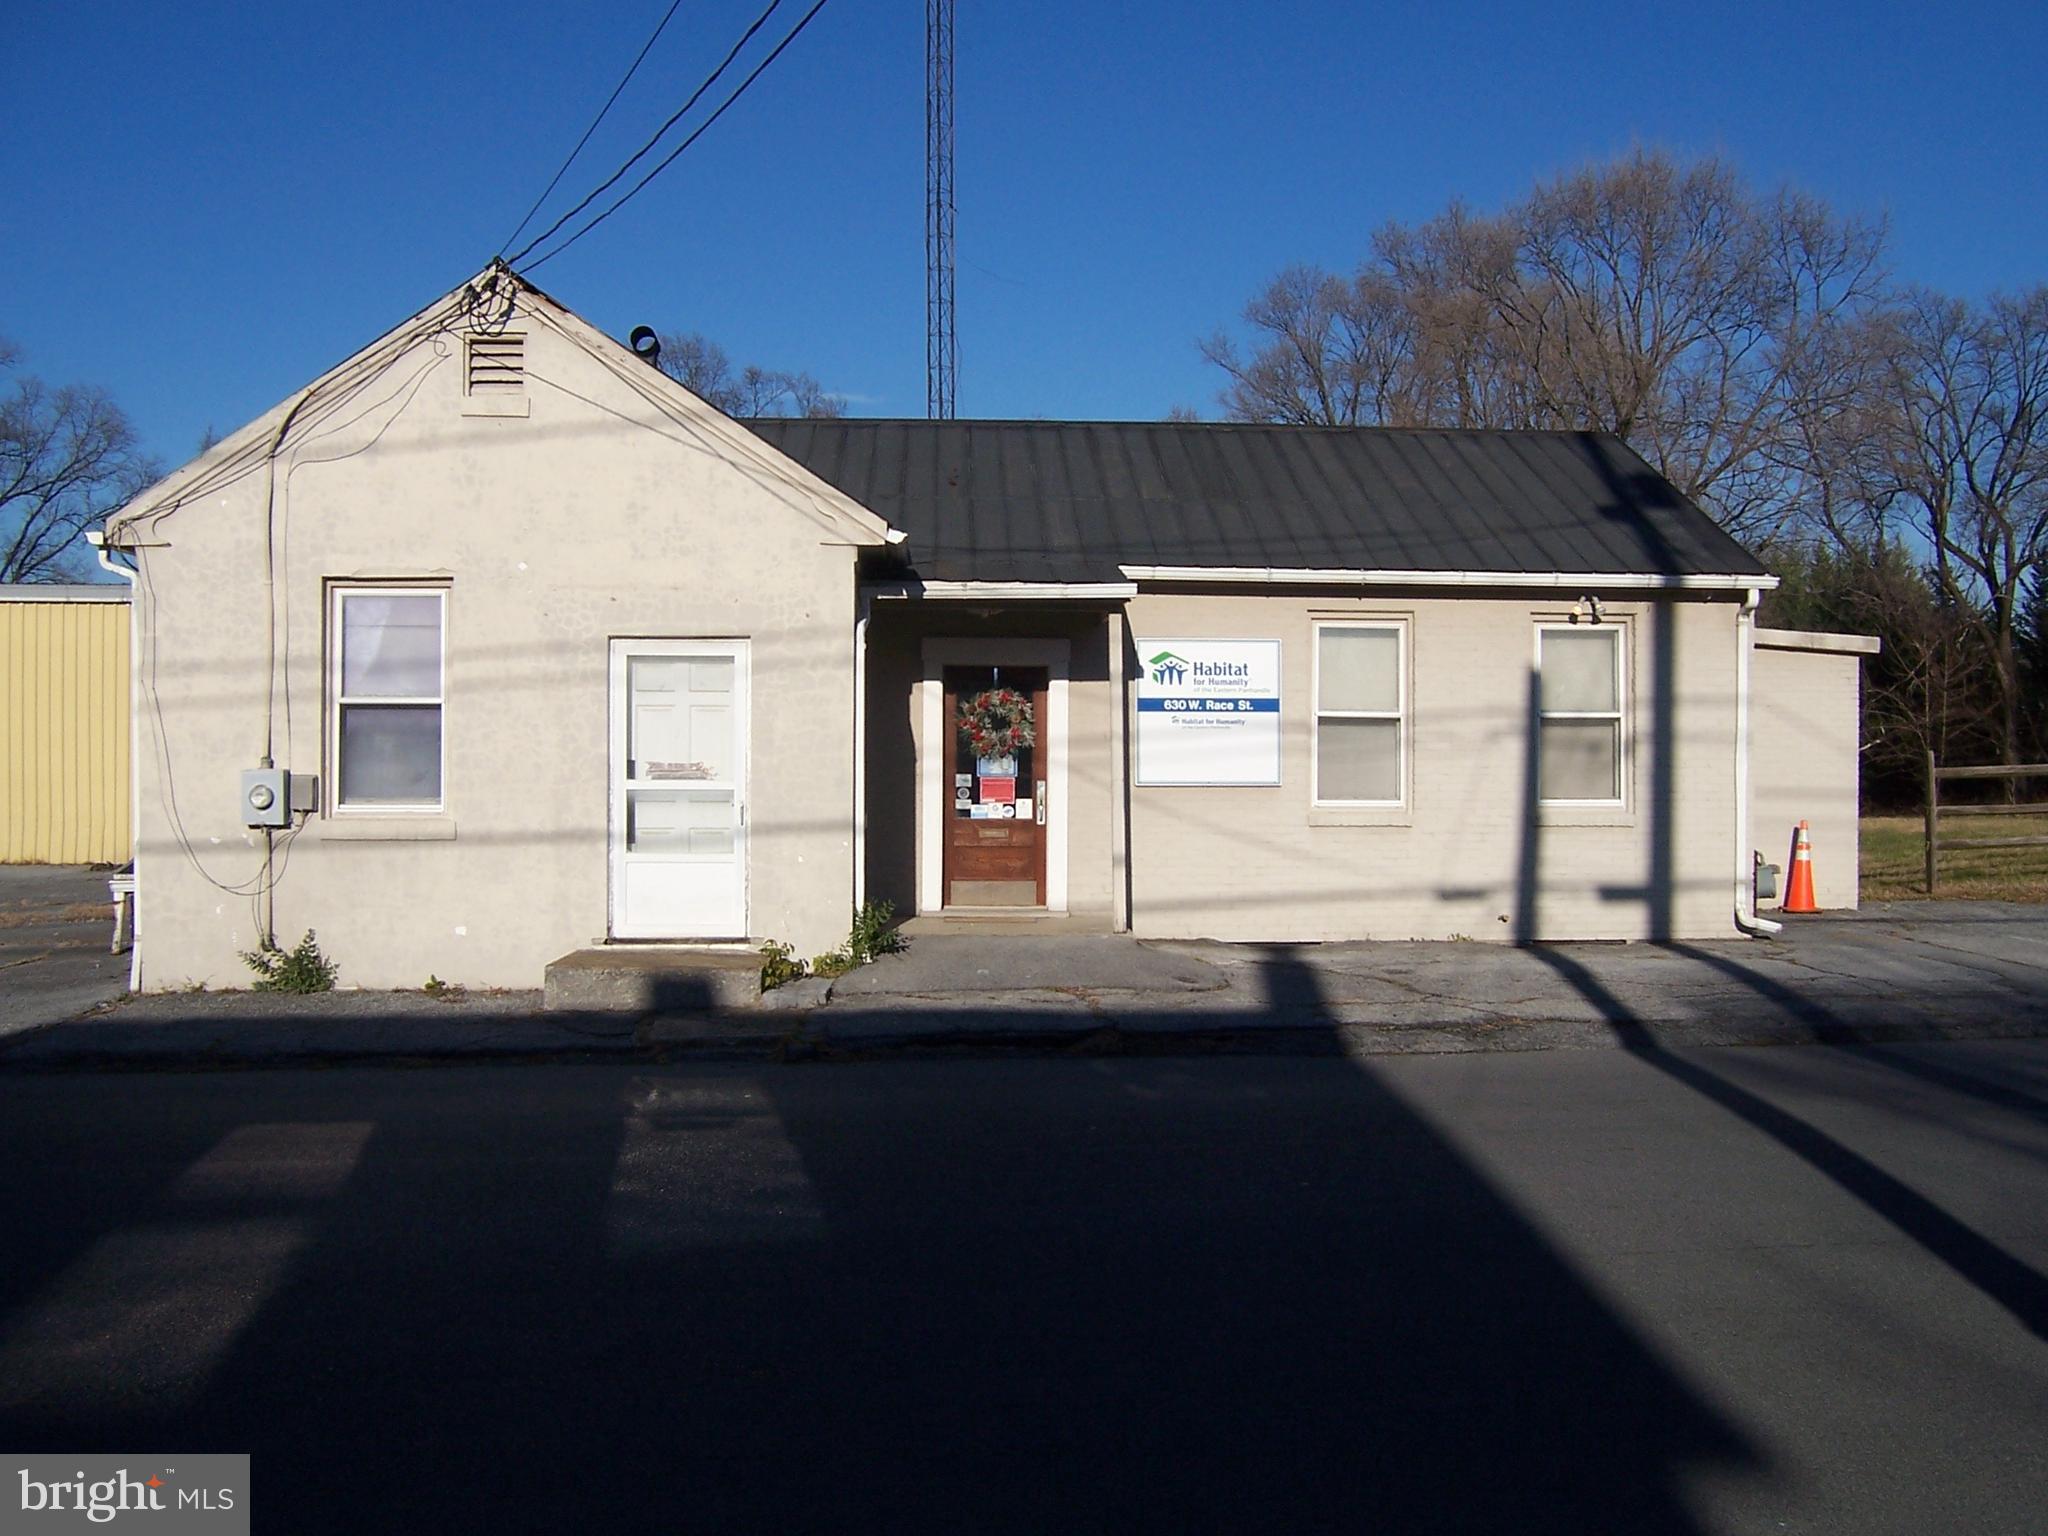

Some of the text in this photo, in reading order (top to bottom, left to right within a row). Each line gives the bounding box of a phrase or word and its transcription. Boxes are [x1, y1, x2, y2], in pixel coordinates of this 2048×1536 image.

[1193, 662, 1248, 676] Habitat
[1193, 678, 1248, 687] for Humanity
[1163, 700, 1254, 710] 630 W. Race St.
